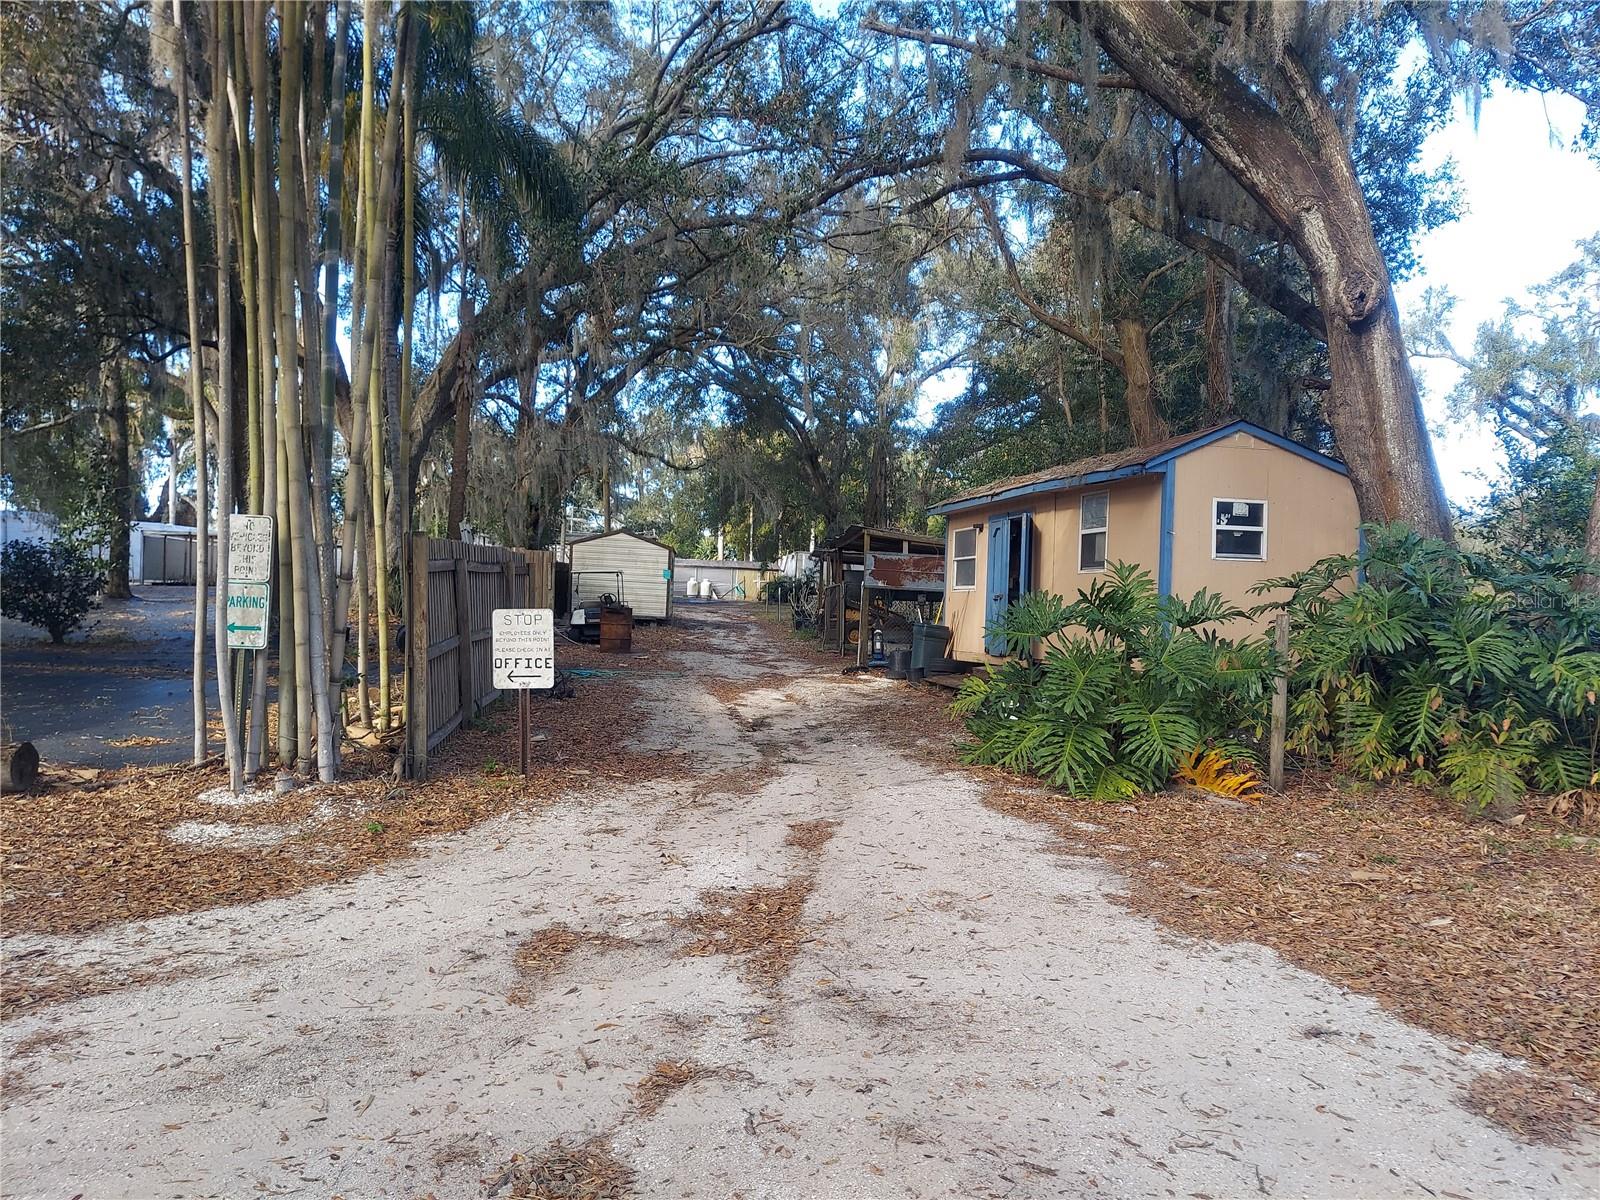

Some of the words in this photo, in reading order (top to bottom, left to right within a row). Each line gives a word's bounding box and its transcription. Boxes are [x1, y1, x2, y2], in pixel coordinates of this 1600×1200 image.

[230, 543, 265, 553] BEYOND
[504, 614, 543, 626] STOP
[494, 657, 553, 668] OFFICE
